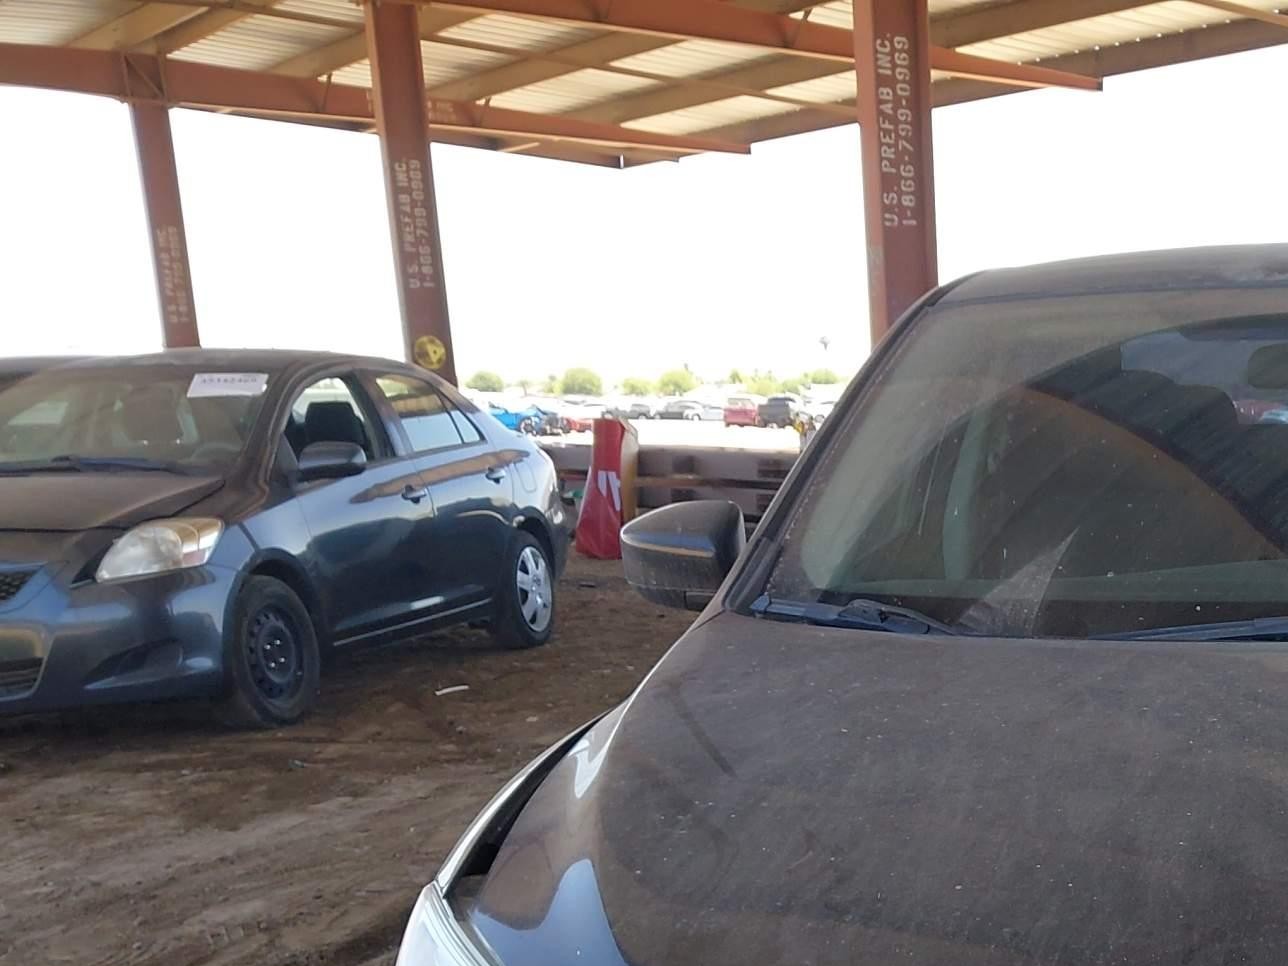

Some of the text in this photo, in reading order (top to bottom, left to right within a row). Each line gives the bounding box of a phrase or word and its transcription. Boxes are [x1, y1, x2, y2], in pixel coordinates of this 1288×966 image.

[876, 33, 898, 227] U.S. PREFAB INC.
[894, 36, 917, 226] 1-866-799-0969
